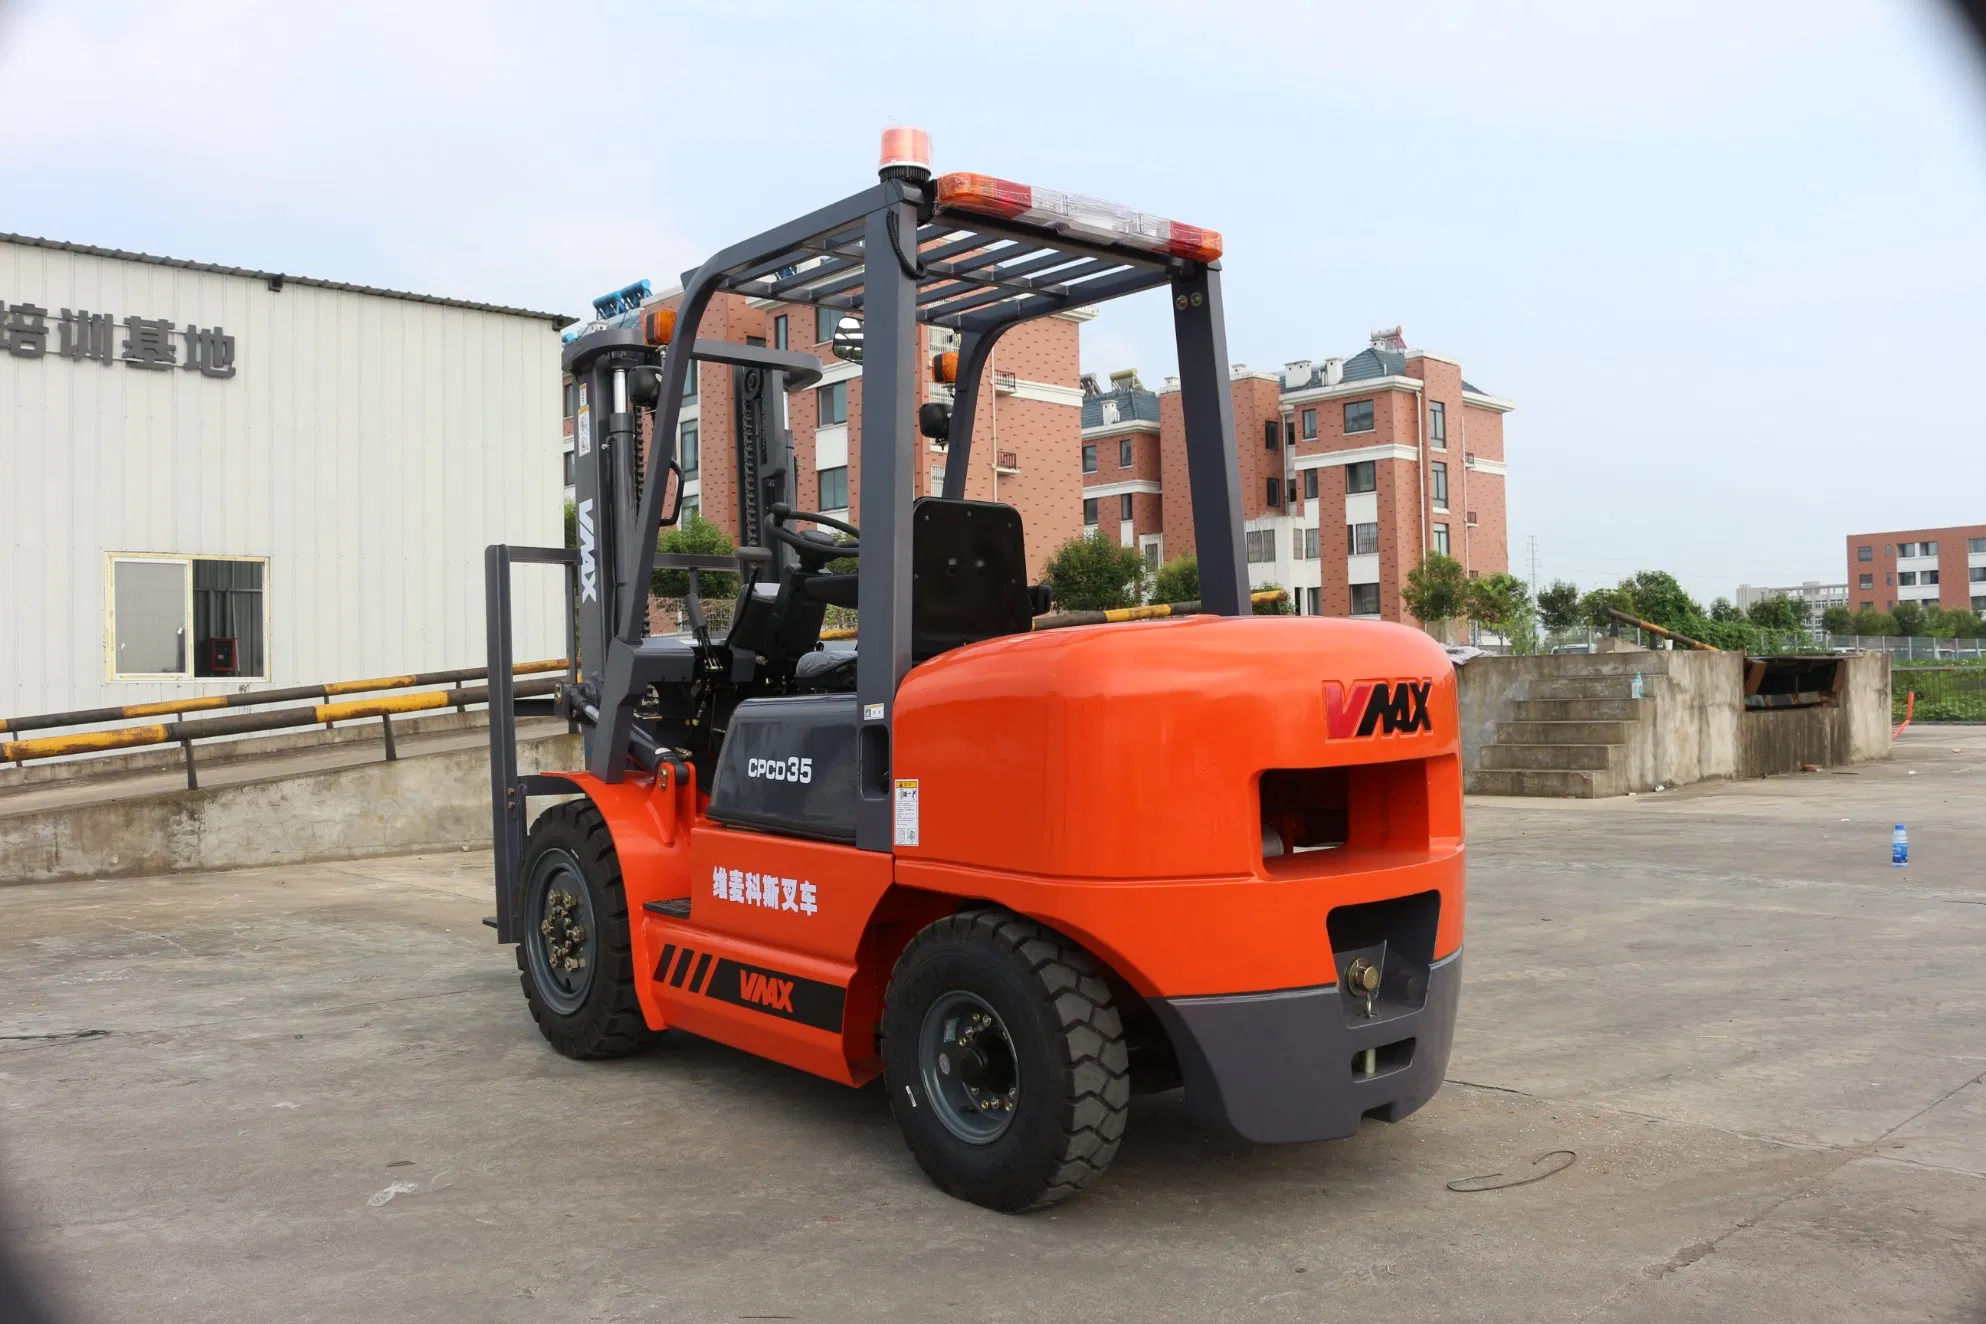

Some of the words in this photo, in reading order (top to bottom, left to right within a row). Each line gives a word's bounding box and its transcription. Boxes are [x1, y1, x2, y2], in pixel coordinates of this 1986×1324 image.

[579, 498, 597, 603] VMAX
[1324, 680, 1432, 741] VMAX
[712, 865, 818, 916] 维麦科斯叉车
[740, 969, 794, 1013] VMAX
